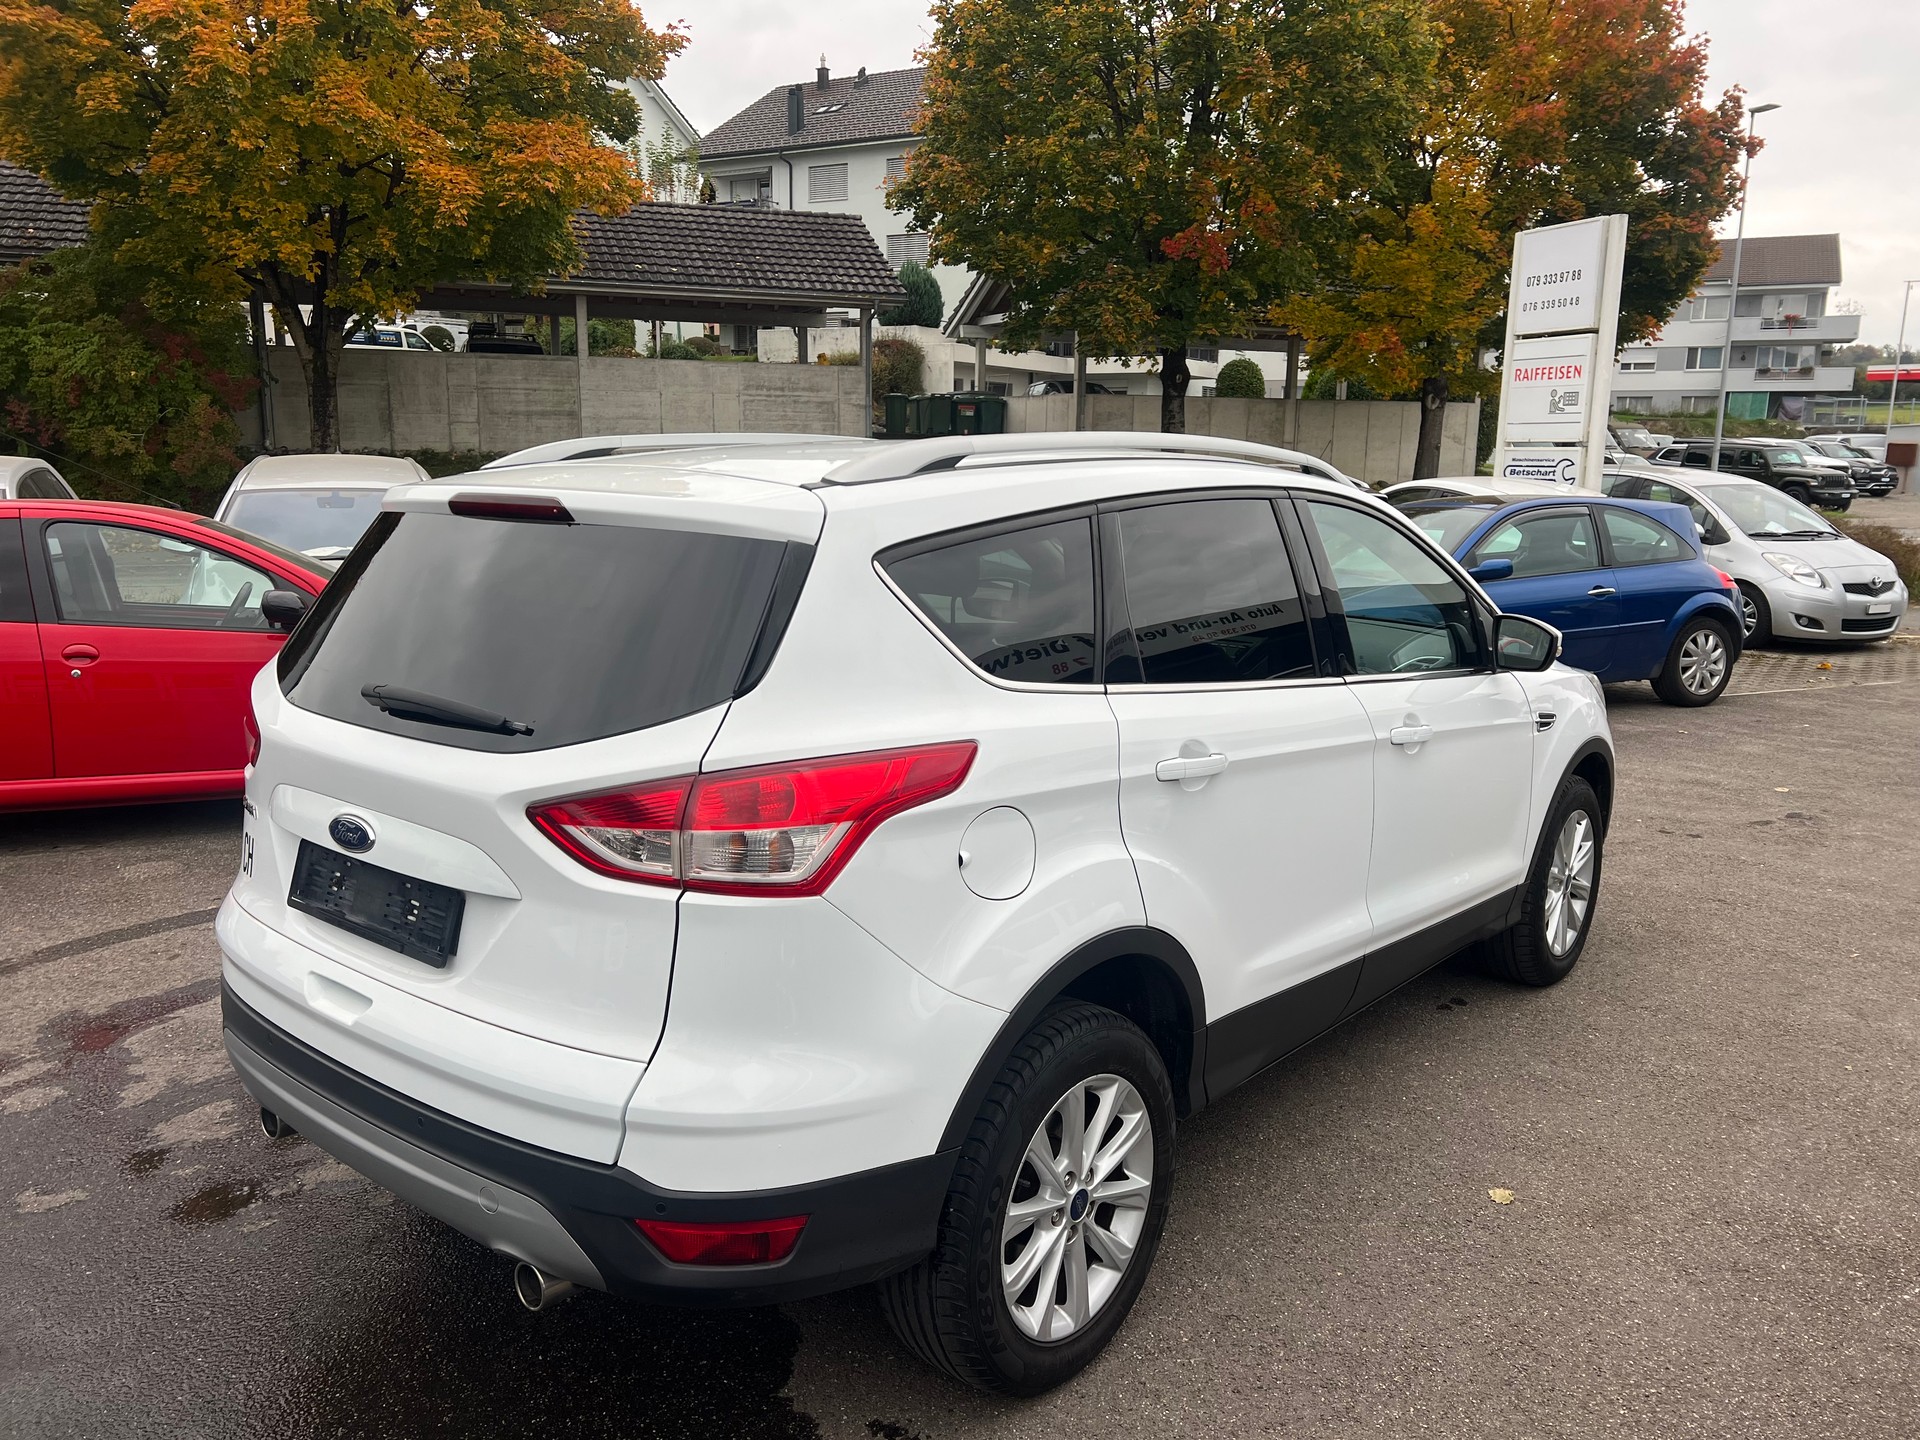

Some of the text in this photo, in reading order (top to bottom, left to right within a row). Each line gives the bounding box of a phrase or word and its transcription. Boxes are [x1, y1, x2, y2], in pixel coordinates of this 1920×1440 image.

[1526, 269, 1582, 287] 079 333 97 88
[1522, 296, 1580, 312] 076 339 50 48
[1514, 365, 1582, 382] RAIFFEISEN
[1509, 468, 1556, 477] Betschart
[243, 831, 255, 878] CH
